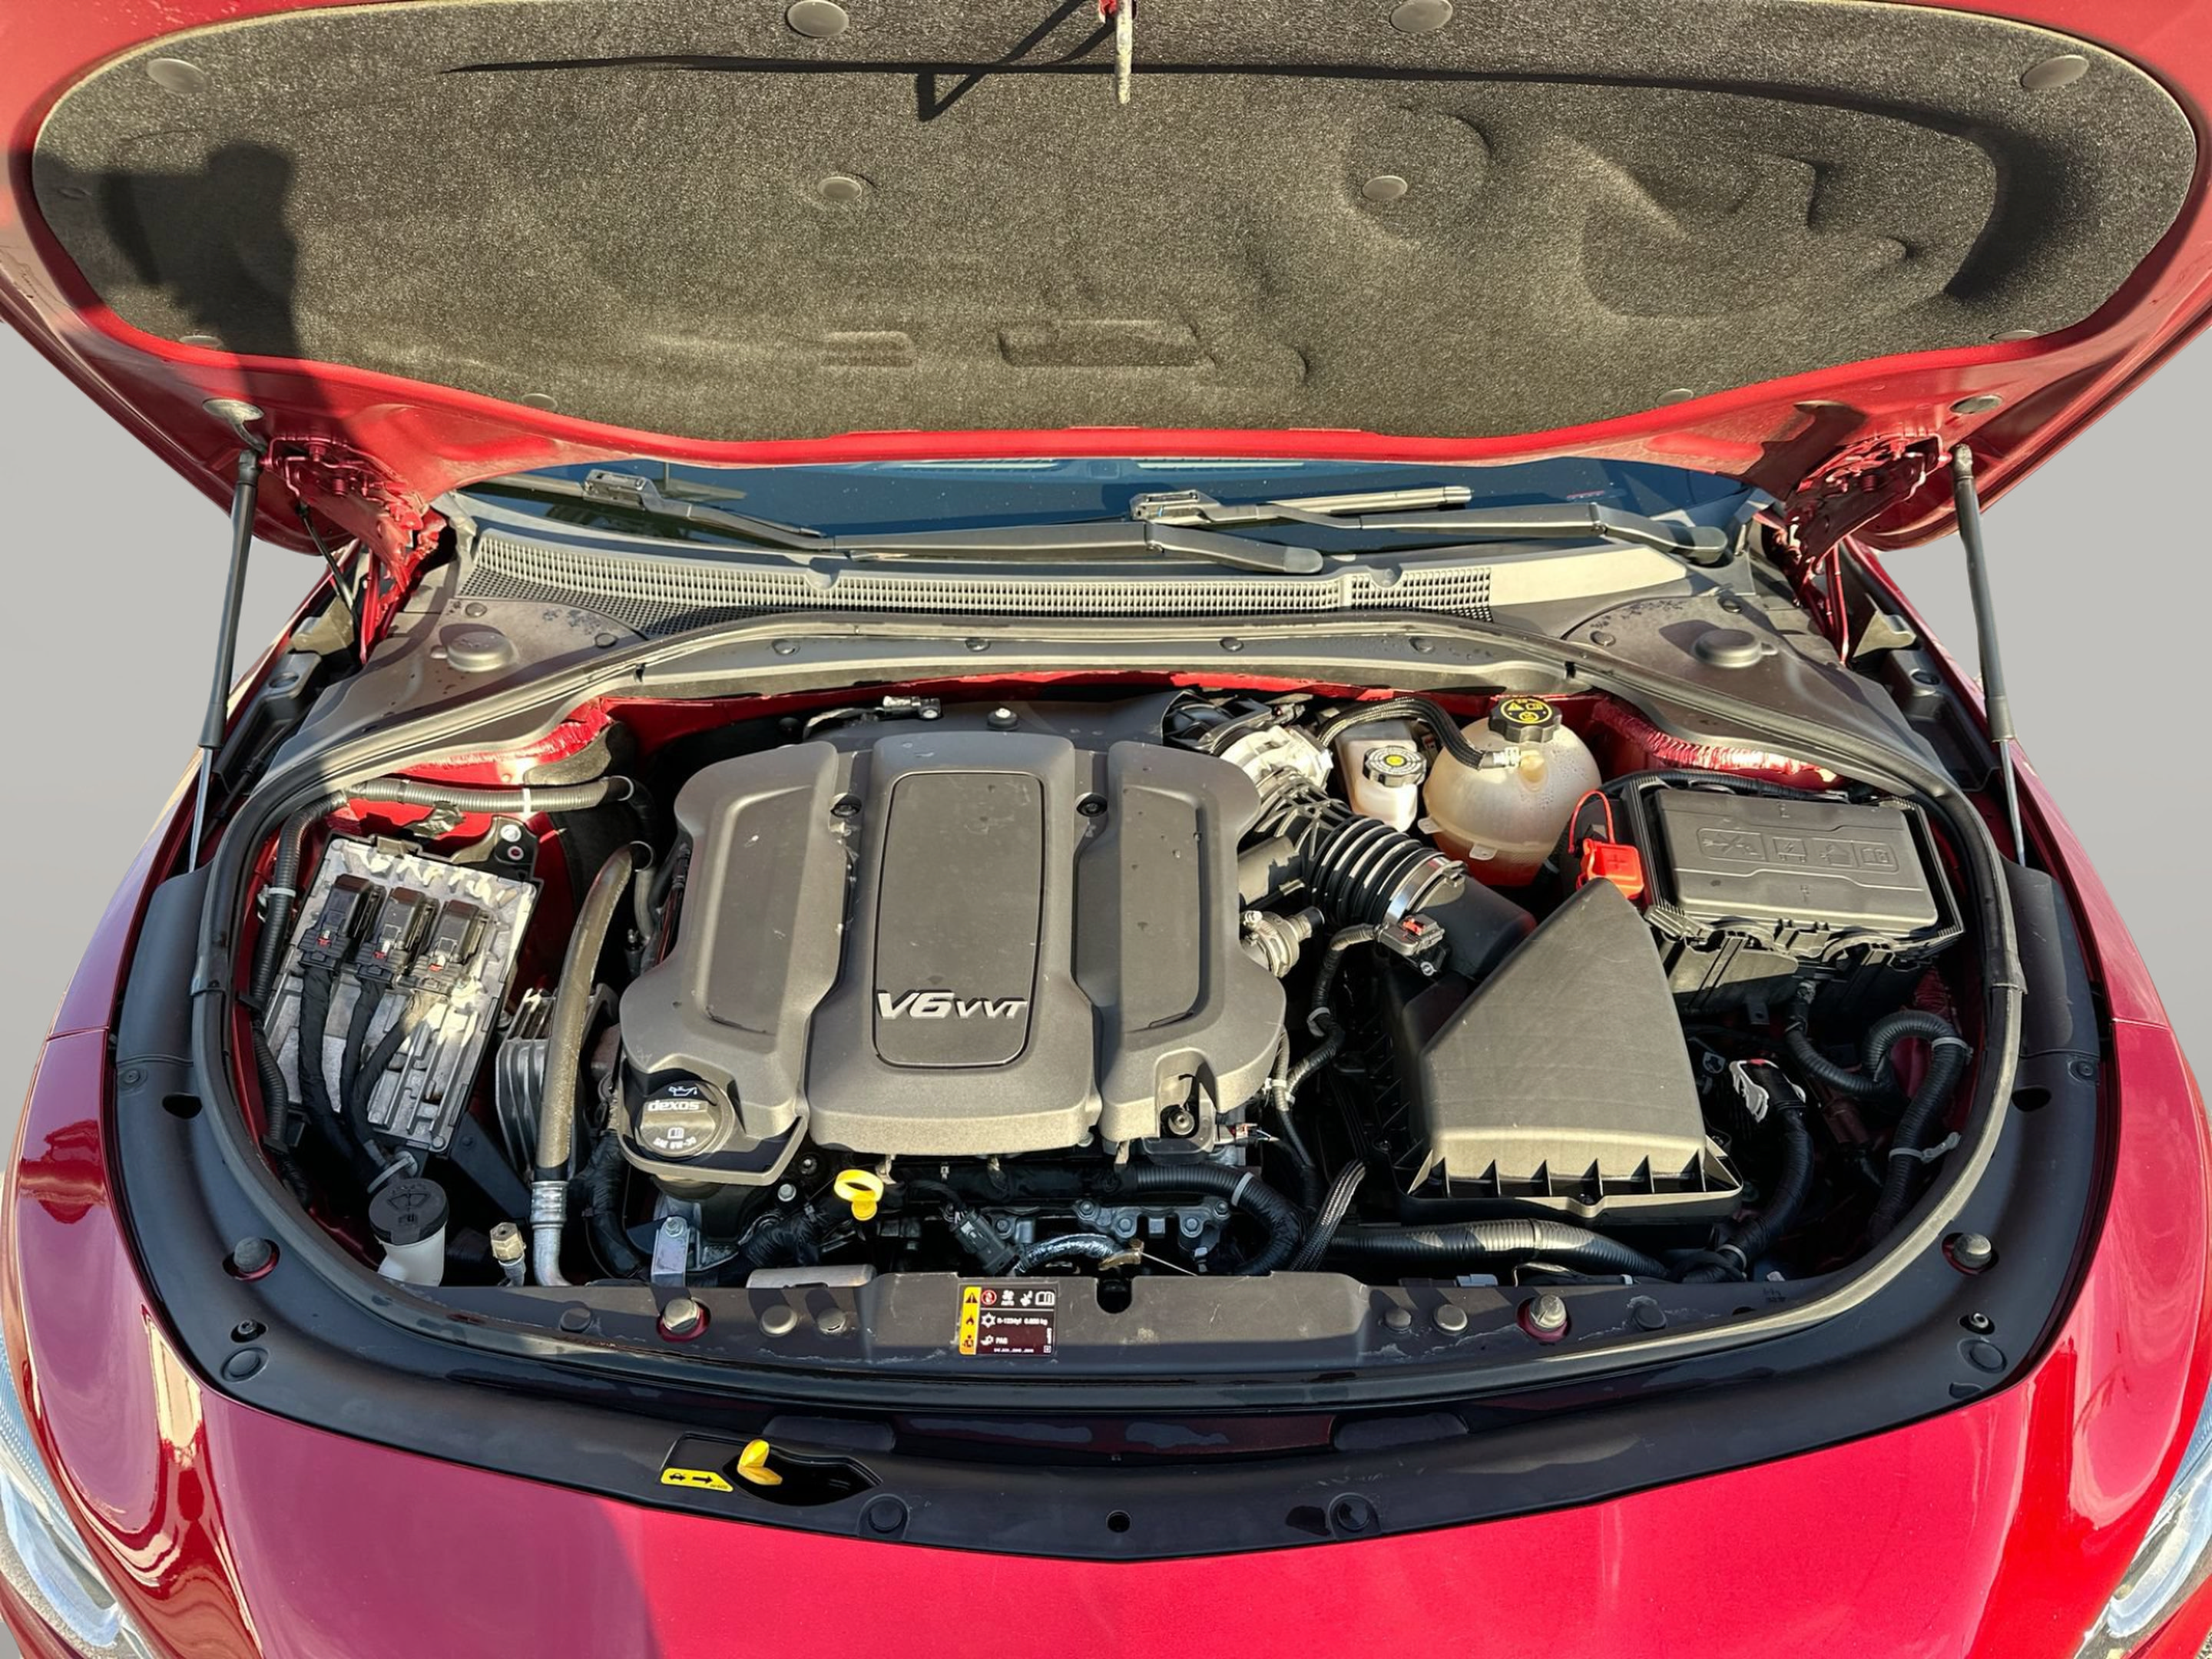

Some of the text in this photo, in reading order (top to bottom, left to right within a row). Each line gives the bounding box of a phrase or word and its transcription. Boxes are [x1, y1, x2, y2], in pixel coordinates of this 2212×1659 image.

[877, 992, 1028, 1019] V6 VVT
[647, 1100, 700, 1111] dexos
